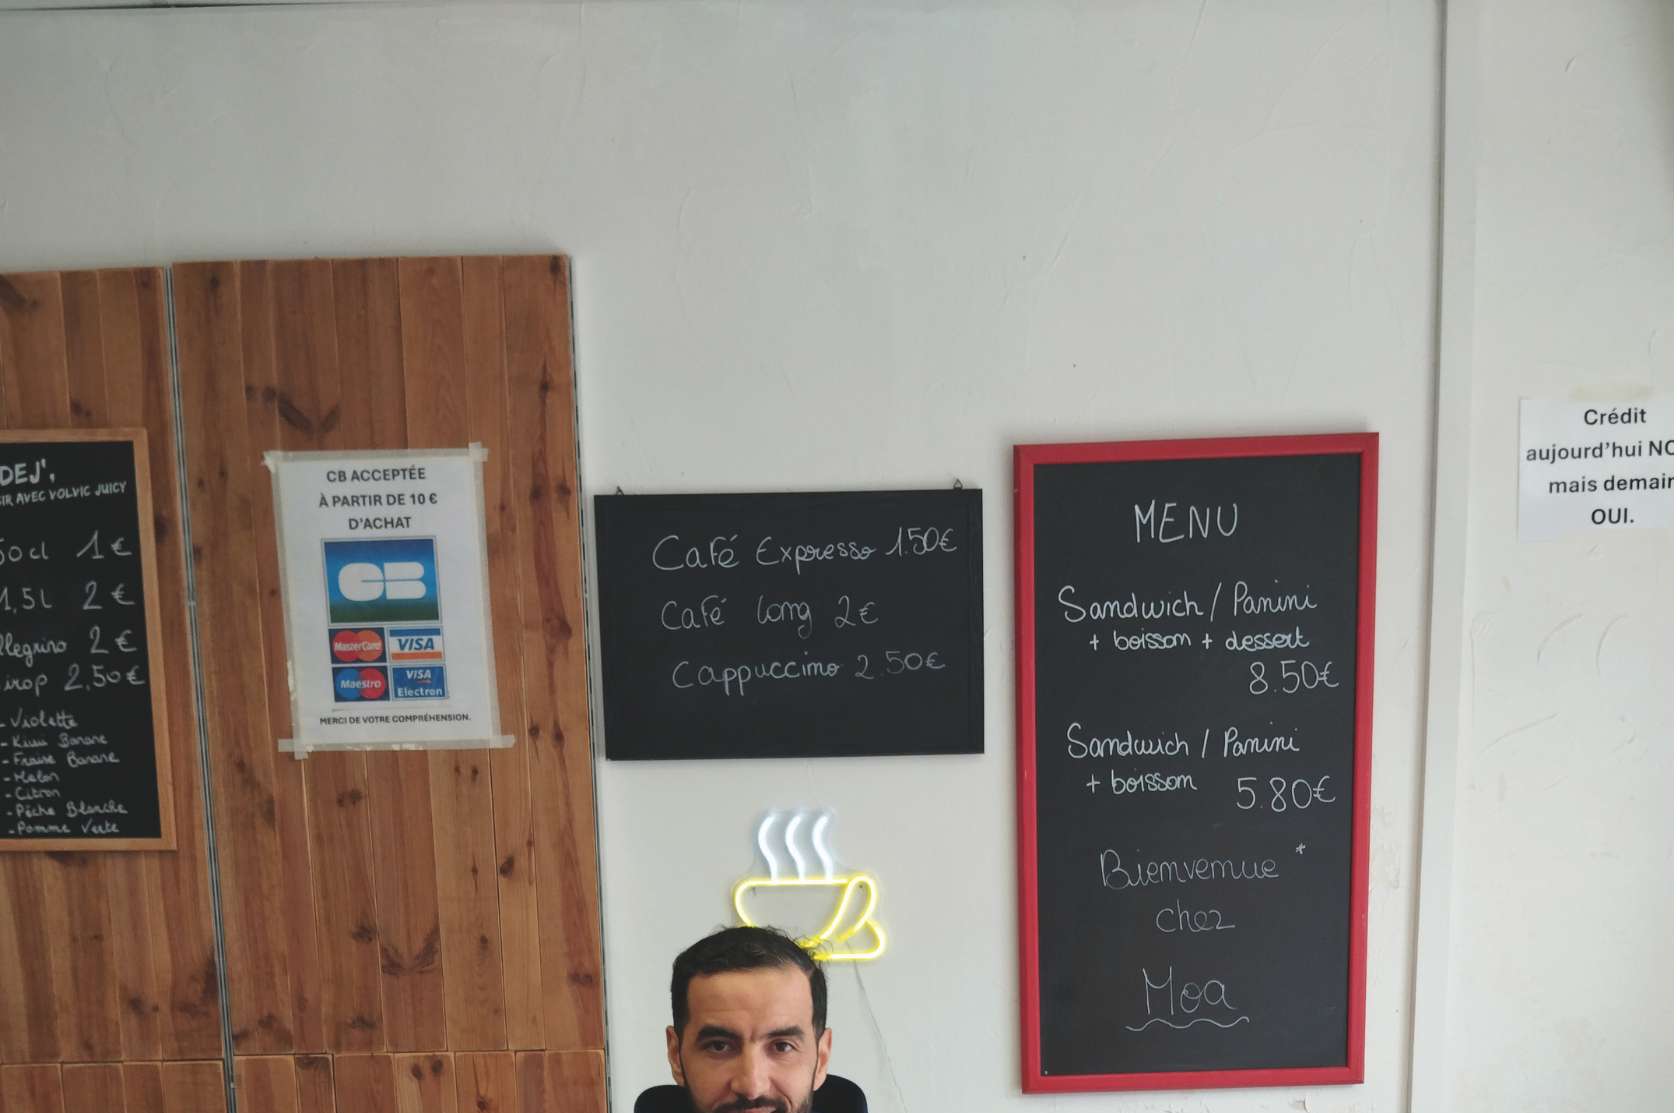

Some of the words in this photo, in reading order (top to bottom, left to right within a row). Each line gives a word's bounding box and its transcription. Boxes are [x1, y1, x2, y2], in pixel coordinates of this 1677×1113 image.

[1584, 408, 1646, 426] Crédit
[1526, 440, 1642, 464] aujourd'hui
[326, 470, 347, 482] CB
[350, 464, 426, 482] ACCEPTÉE
[16, 490, 46, 504] AVEC
[50, 486, 90, 500] VOLVIC
[95, 482, 126, 496] JUICY
[1549, 476, 1598, 494] mais
[319, 493, 329, 508] À
[332, 494, 382, 507] PARTIR
[386, 494, 405, 506] DE
[410, 493, 426, 505] 10
[348, 517, 412, 530] D'ACHAT
[1134, 499, 1238, 543] MENU
[1591, 508, 1634, 524] OUI.
[652, 534, 740, 570] Café
[756, 536, 877, 575] Expresso
[1058, 585, 1204, 623] Sandwich
[1233, 579, 1318, 616] Panini
[662, 595, 726, 630] Café
[334, 640, 382, 652] MasterCard
[397, 638, 434, 650] VISA
[1090, 634, 1099, 650] +
[1113, 628, 1192, 650] boisson
[1202, 633, 1212, 650] +
[1225, 626, 1310, 652] dessert
[406, 670, 432, 680] VISA
[672, 652, 840, 696] Cappuccino
[340, 680, 382, 689] Maestro
[397, 687, 442, 696] Electron
[10, 708, 78, 730] Violette
[320, 717, 348, 725] MERCI
[350, 716, 362, 724] DE
[362, 716, 390, 724] VOTRE
[392, 713, 472, 724] COMPRÉHENSION.
[12, 734, 48, 748] Kiwi
[58, 732, 108, 748] Banane
[1066, 722, 1189, 758] Sandwich
[1223, 720, 1300, 758] Panini
[14, 752, 56, 766] Fraise
[66, 750, 120, 768] Banane
[14, 769, 60, 783] Melon
[1086, 774, 1100, 793] +
[1111, 768, 1198, 794] boisson
[15, 786, 61, 800] Citron
[66, 800, 128, 818] Blanche
[18, 821, 71, 834] Pomme
[81, 818, 120, 834] Verte
[1100, 848, 1280, 890] Bienvenue
[1156, 899, 1236, 932] chez
